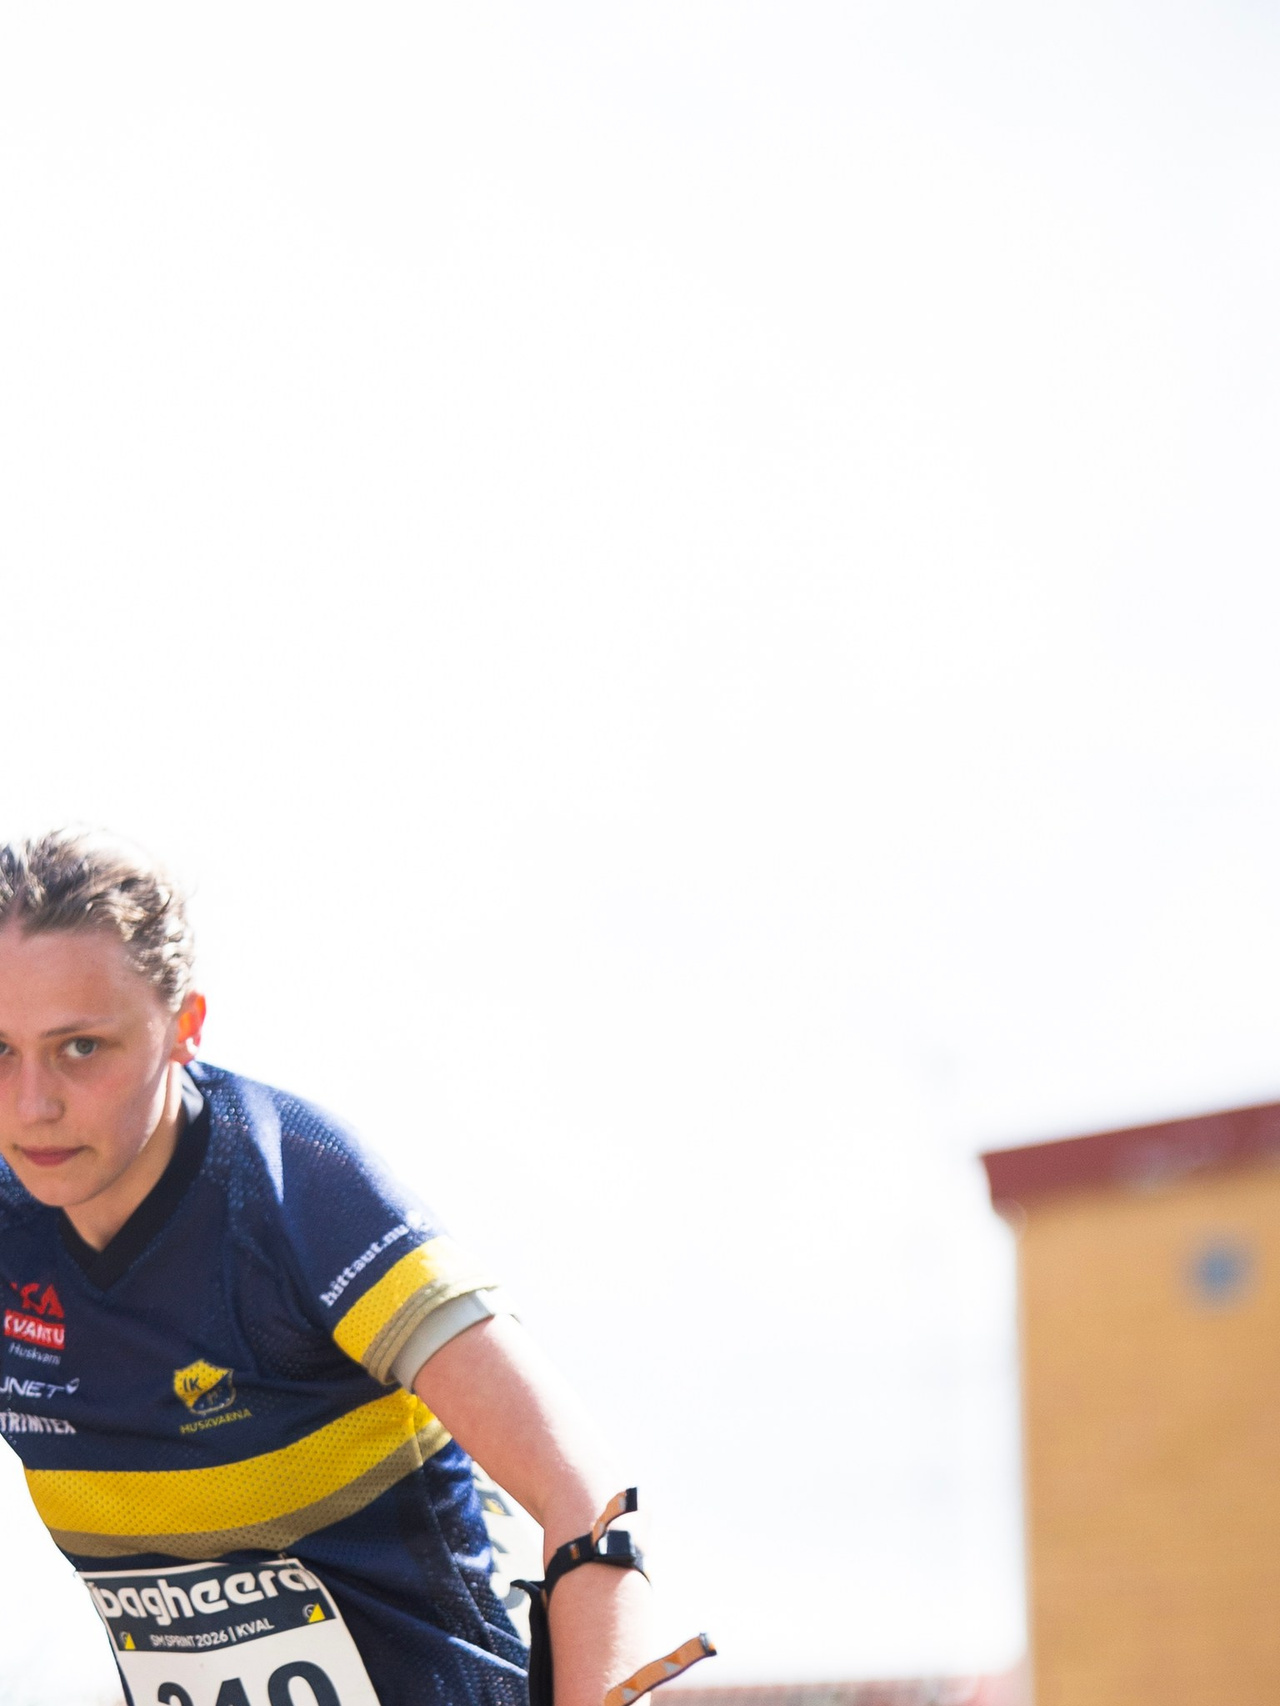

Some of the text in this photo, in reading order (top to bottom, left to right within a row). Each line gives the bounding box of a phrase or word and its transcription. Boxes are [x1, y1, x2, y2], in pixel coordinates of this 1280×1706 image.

[179, 1408, 253, 1434] HUSKVARNA
[95, 1568, 319, 1626] bagheera
[165, 1634, 196, 1648] SPRINT
[195, 1629, 229, 1648] 2026
[236, 1617, 276, 1638] KVAL
